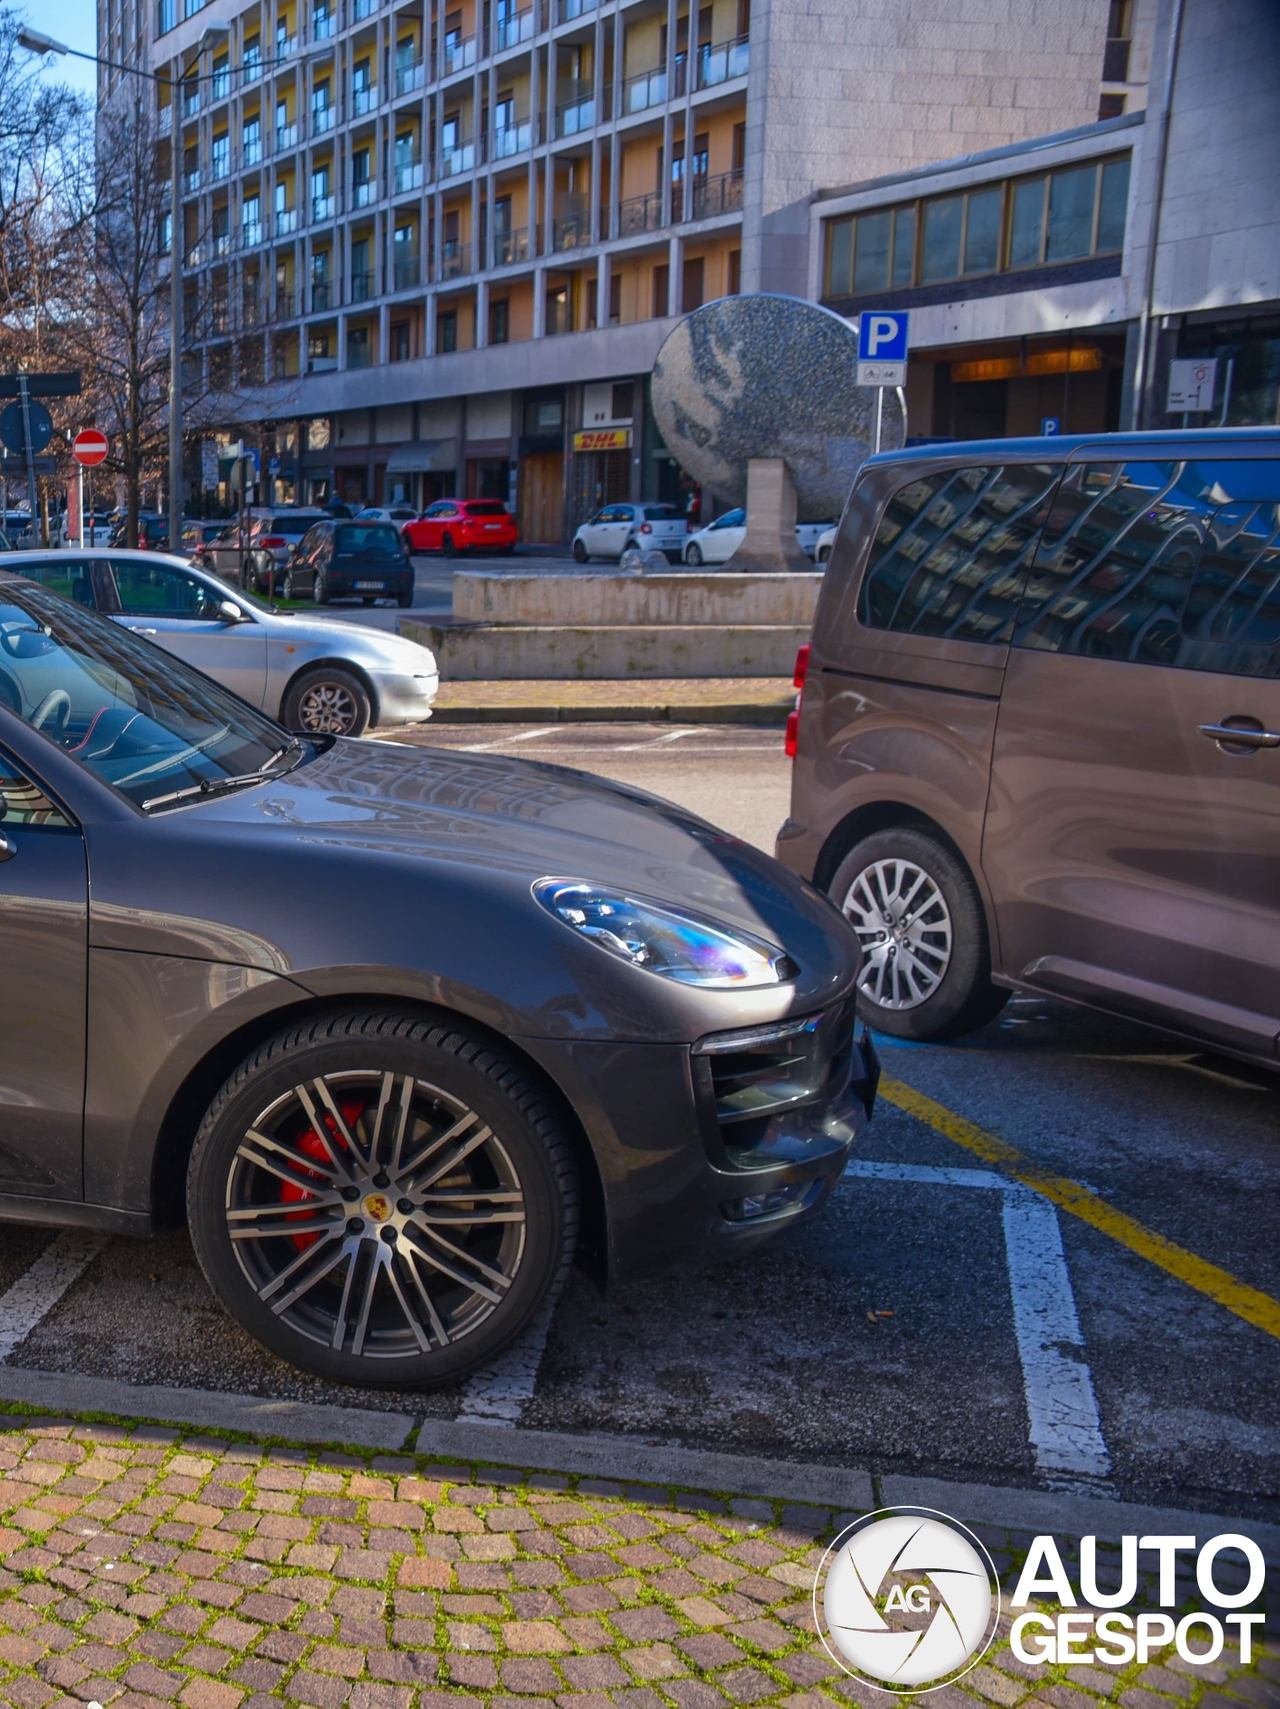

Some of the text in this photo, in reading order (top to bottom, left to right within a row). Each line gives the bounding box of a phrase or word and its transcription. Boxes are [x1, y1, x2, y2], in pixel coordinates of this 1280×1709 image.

[868, 317, 898, 355] P
[1045, 420, 1056, 436] P
[581, 432, 618, 449] DHL
